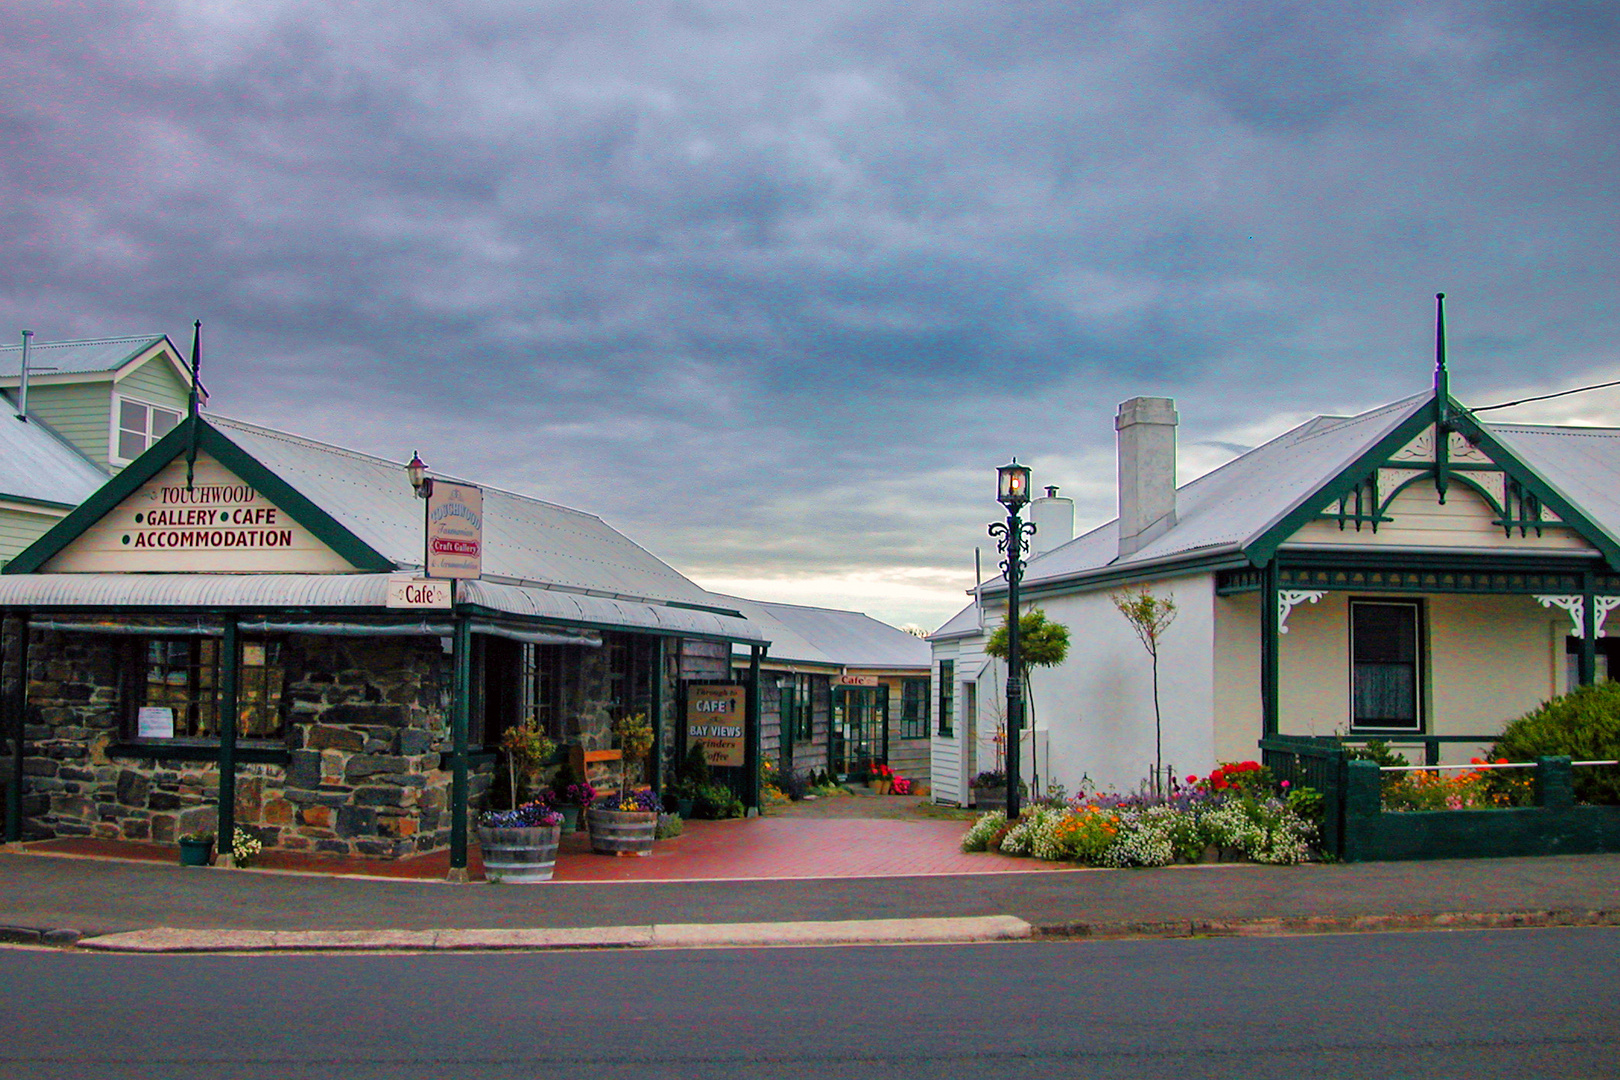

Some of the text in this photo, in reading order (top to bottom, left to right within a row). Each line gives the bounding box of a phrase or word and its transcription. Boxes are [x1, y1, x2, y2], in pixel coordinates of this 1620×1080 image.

[161, 486, 255, 504] TOUCHWOOD
[147, 508, 277, 526] GALLERY CAFE
[134, 530, 292, 548] ACCOMMODATION
[434, 541, 477, 554] Craft Gallery
[690, 725, 742, 738] BAY VIEWS
